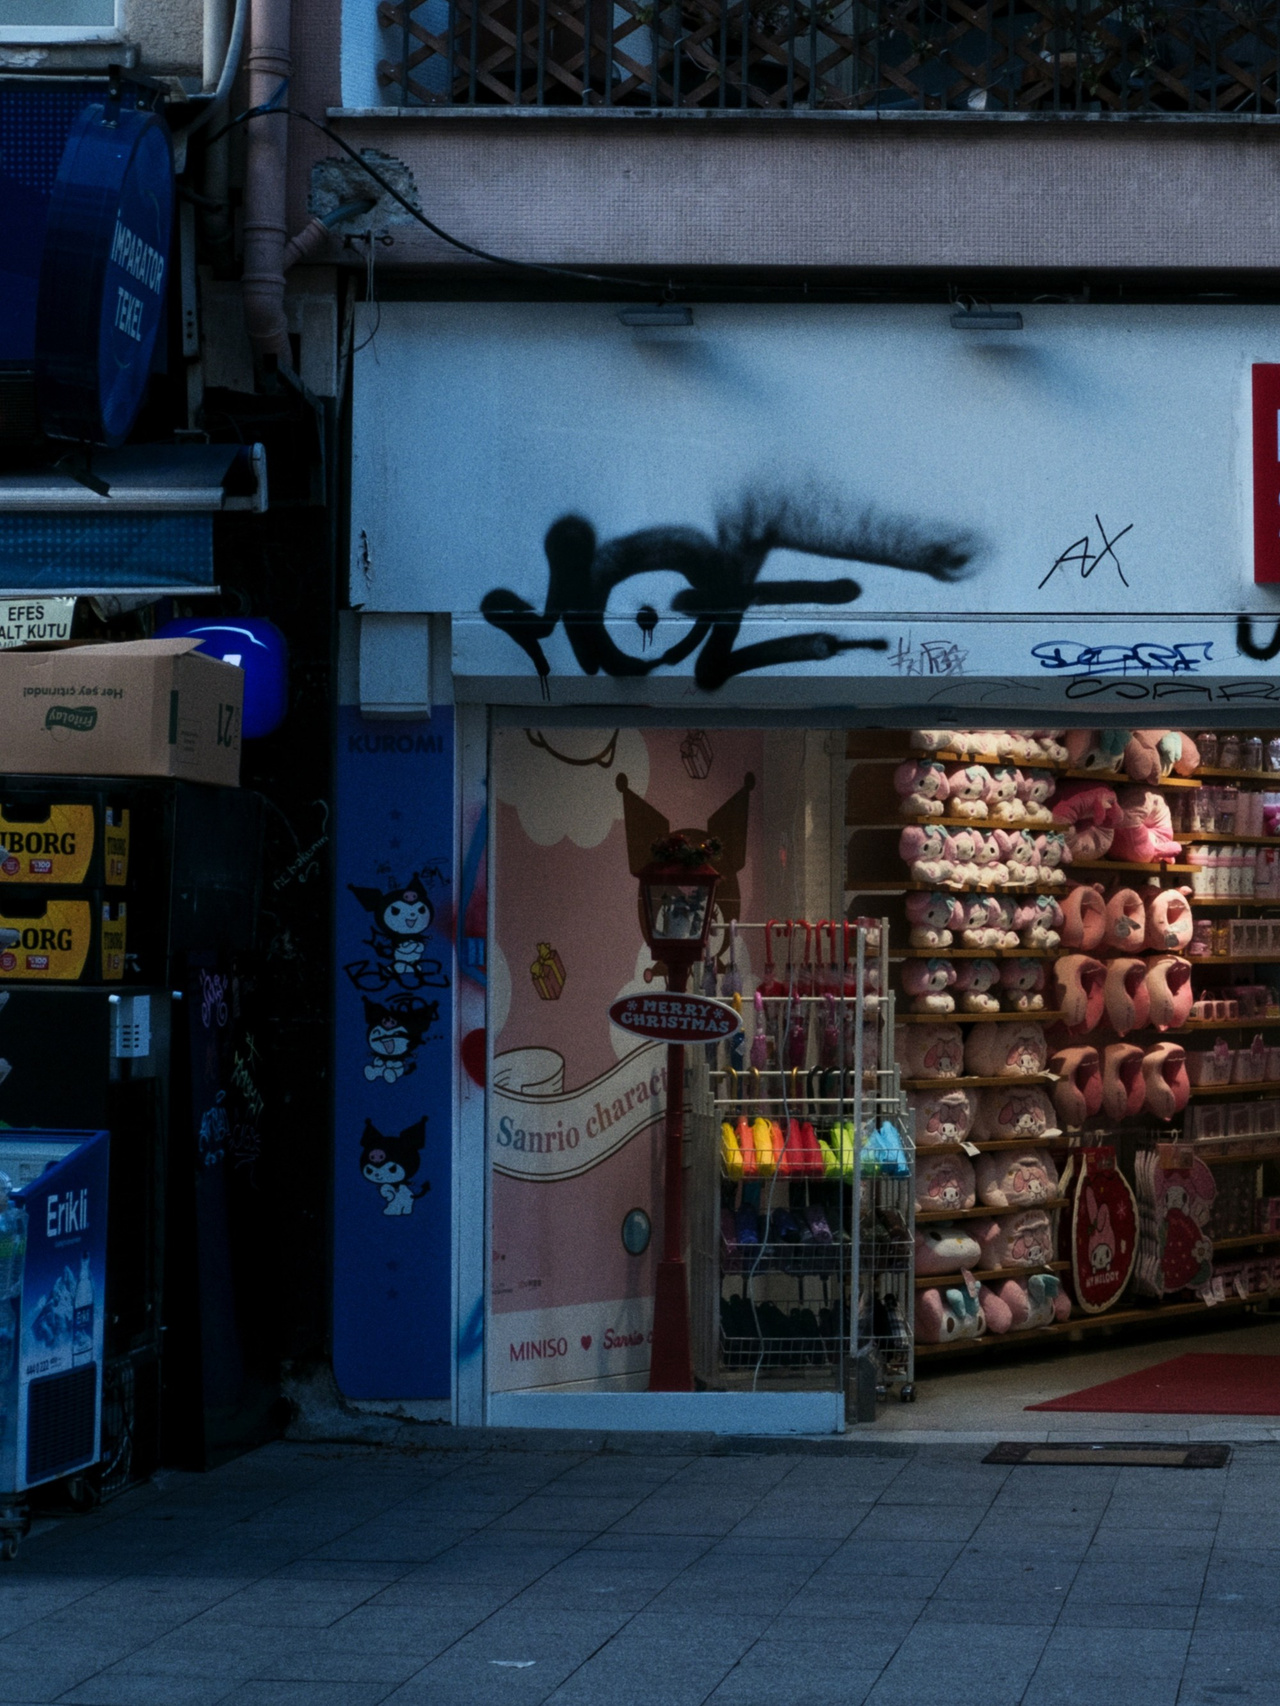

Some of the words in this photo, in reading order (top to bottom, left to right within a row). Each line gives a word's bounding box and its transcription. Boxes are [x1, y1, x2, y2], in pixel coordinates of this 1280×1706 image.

[111, 208, 164, 295] İMPARATOR
[115, 286, 144, 342] TEKEL
[8, 605, 45, 621] EFES
[28, 623, 67, 639] KUTU
[102, 687, 123, 699] Her
[348, 734, 444, 754] KUROMI
[7, 928, 73, 951] ORG
[643, 1000, 711, 1017] MERRY
[620, 1011, 730, 1034] CHRISTMAS
[497, 1115, 580, 1153] Sanrio
[586, 1067, 694, 1139] charactr
[46, 1188, 88, 1238] Erikli
[510, 1337, 568, 1362] MINISO
